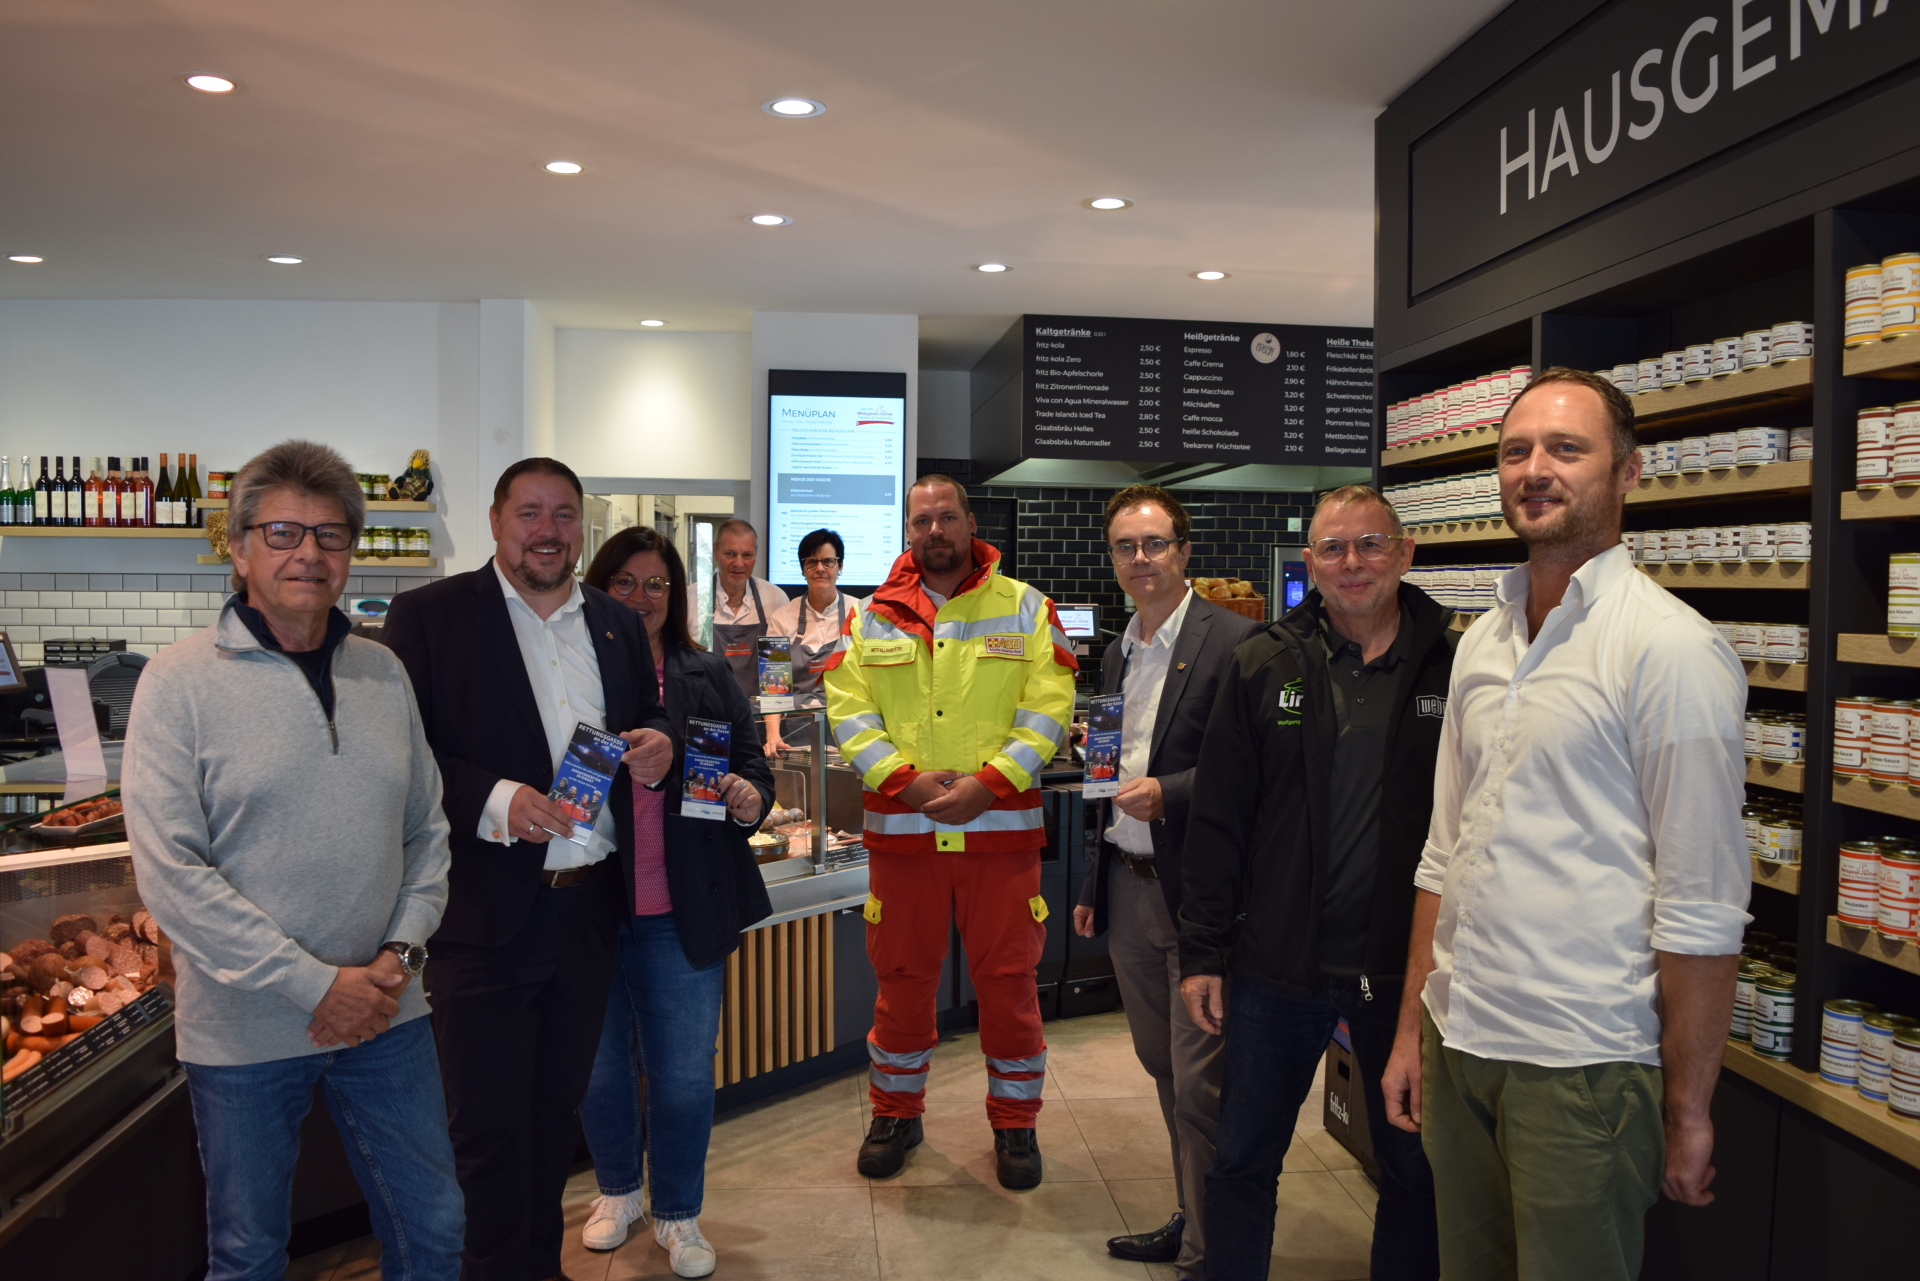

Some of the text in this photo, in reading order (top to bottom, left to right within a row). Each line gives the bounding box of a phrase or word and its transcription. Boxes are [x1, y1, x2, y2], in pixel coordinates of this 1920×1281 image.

[1500, 0, 1888, 214] HAUSGEM
[1036, 327, 1091, 336] Kaltgetränke
[1184, 333, 1240, 342] Heißgetränke
[998, 638, 1021, 649] ASB
[689, 720, 727, 729] RETTUNGSGASSE
[579, 724, 623, 746] RETTUNGSGASSE
[610, 743, 624, 751] Kasse
